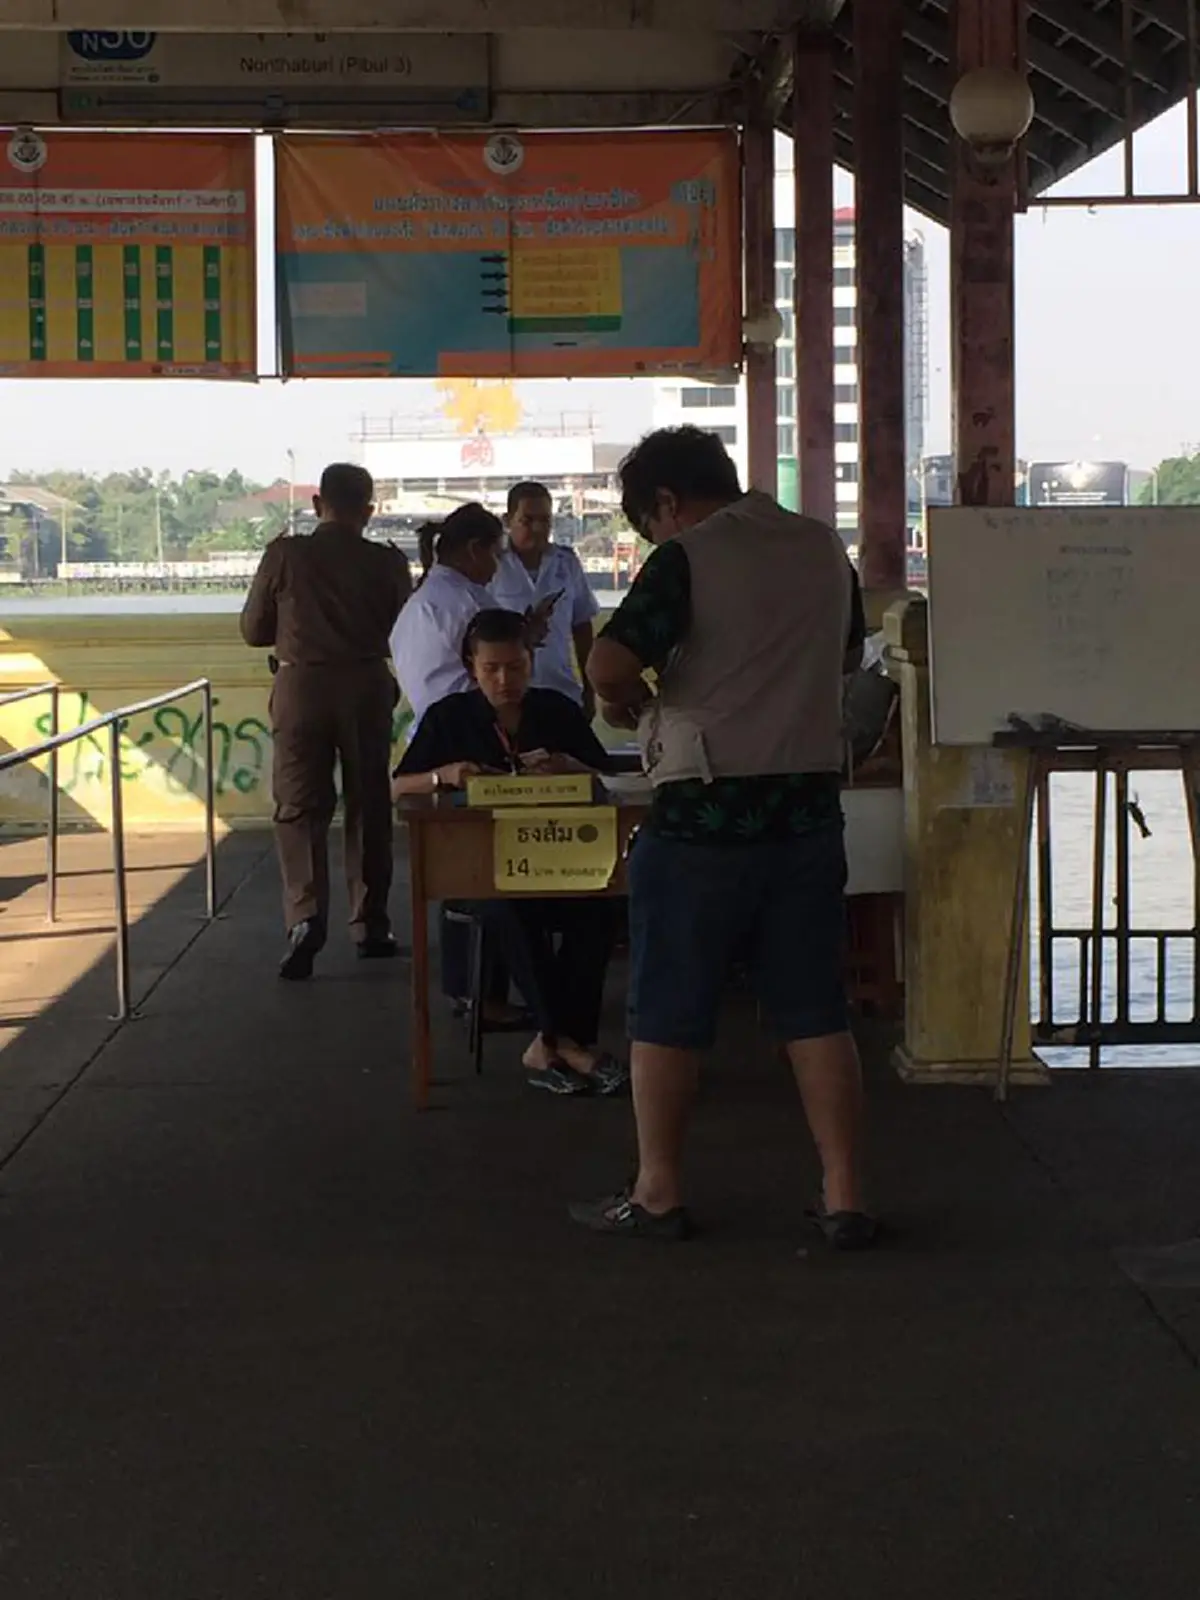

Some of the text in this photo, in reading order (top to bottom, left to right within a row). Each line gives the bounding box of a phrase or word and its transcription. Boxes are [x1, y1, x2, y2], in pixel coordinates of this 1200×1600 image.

[239, 55, 414, 76] Nonthaburi (Pibul 3)
[517, 818, 573, 844] ธงส้ม
[506, 858, 530, 878] 14
